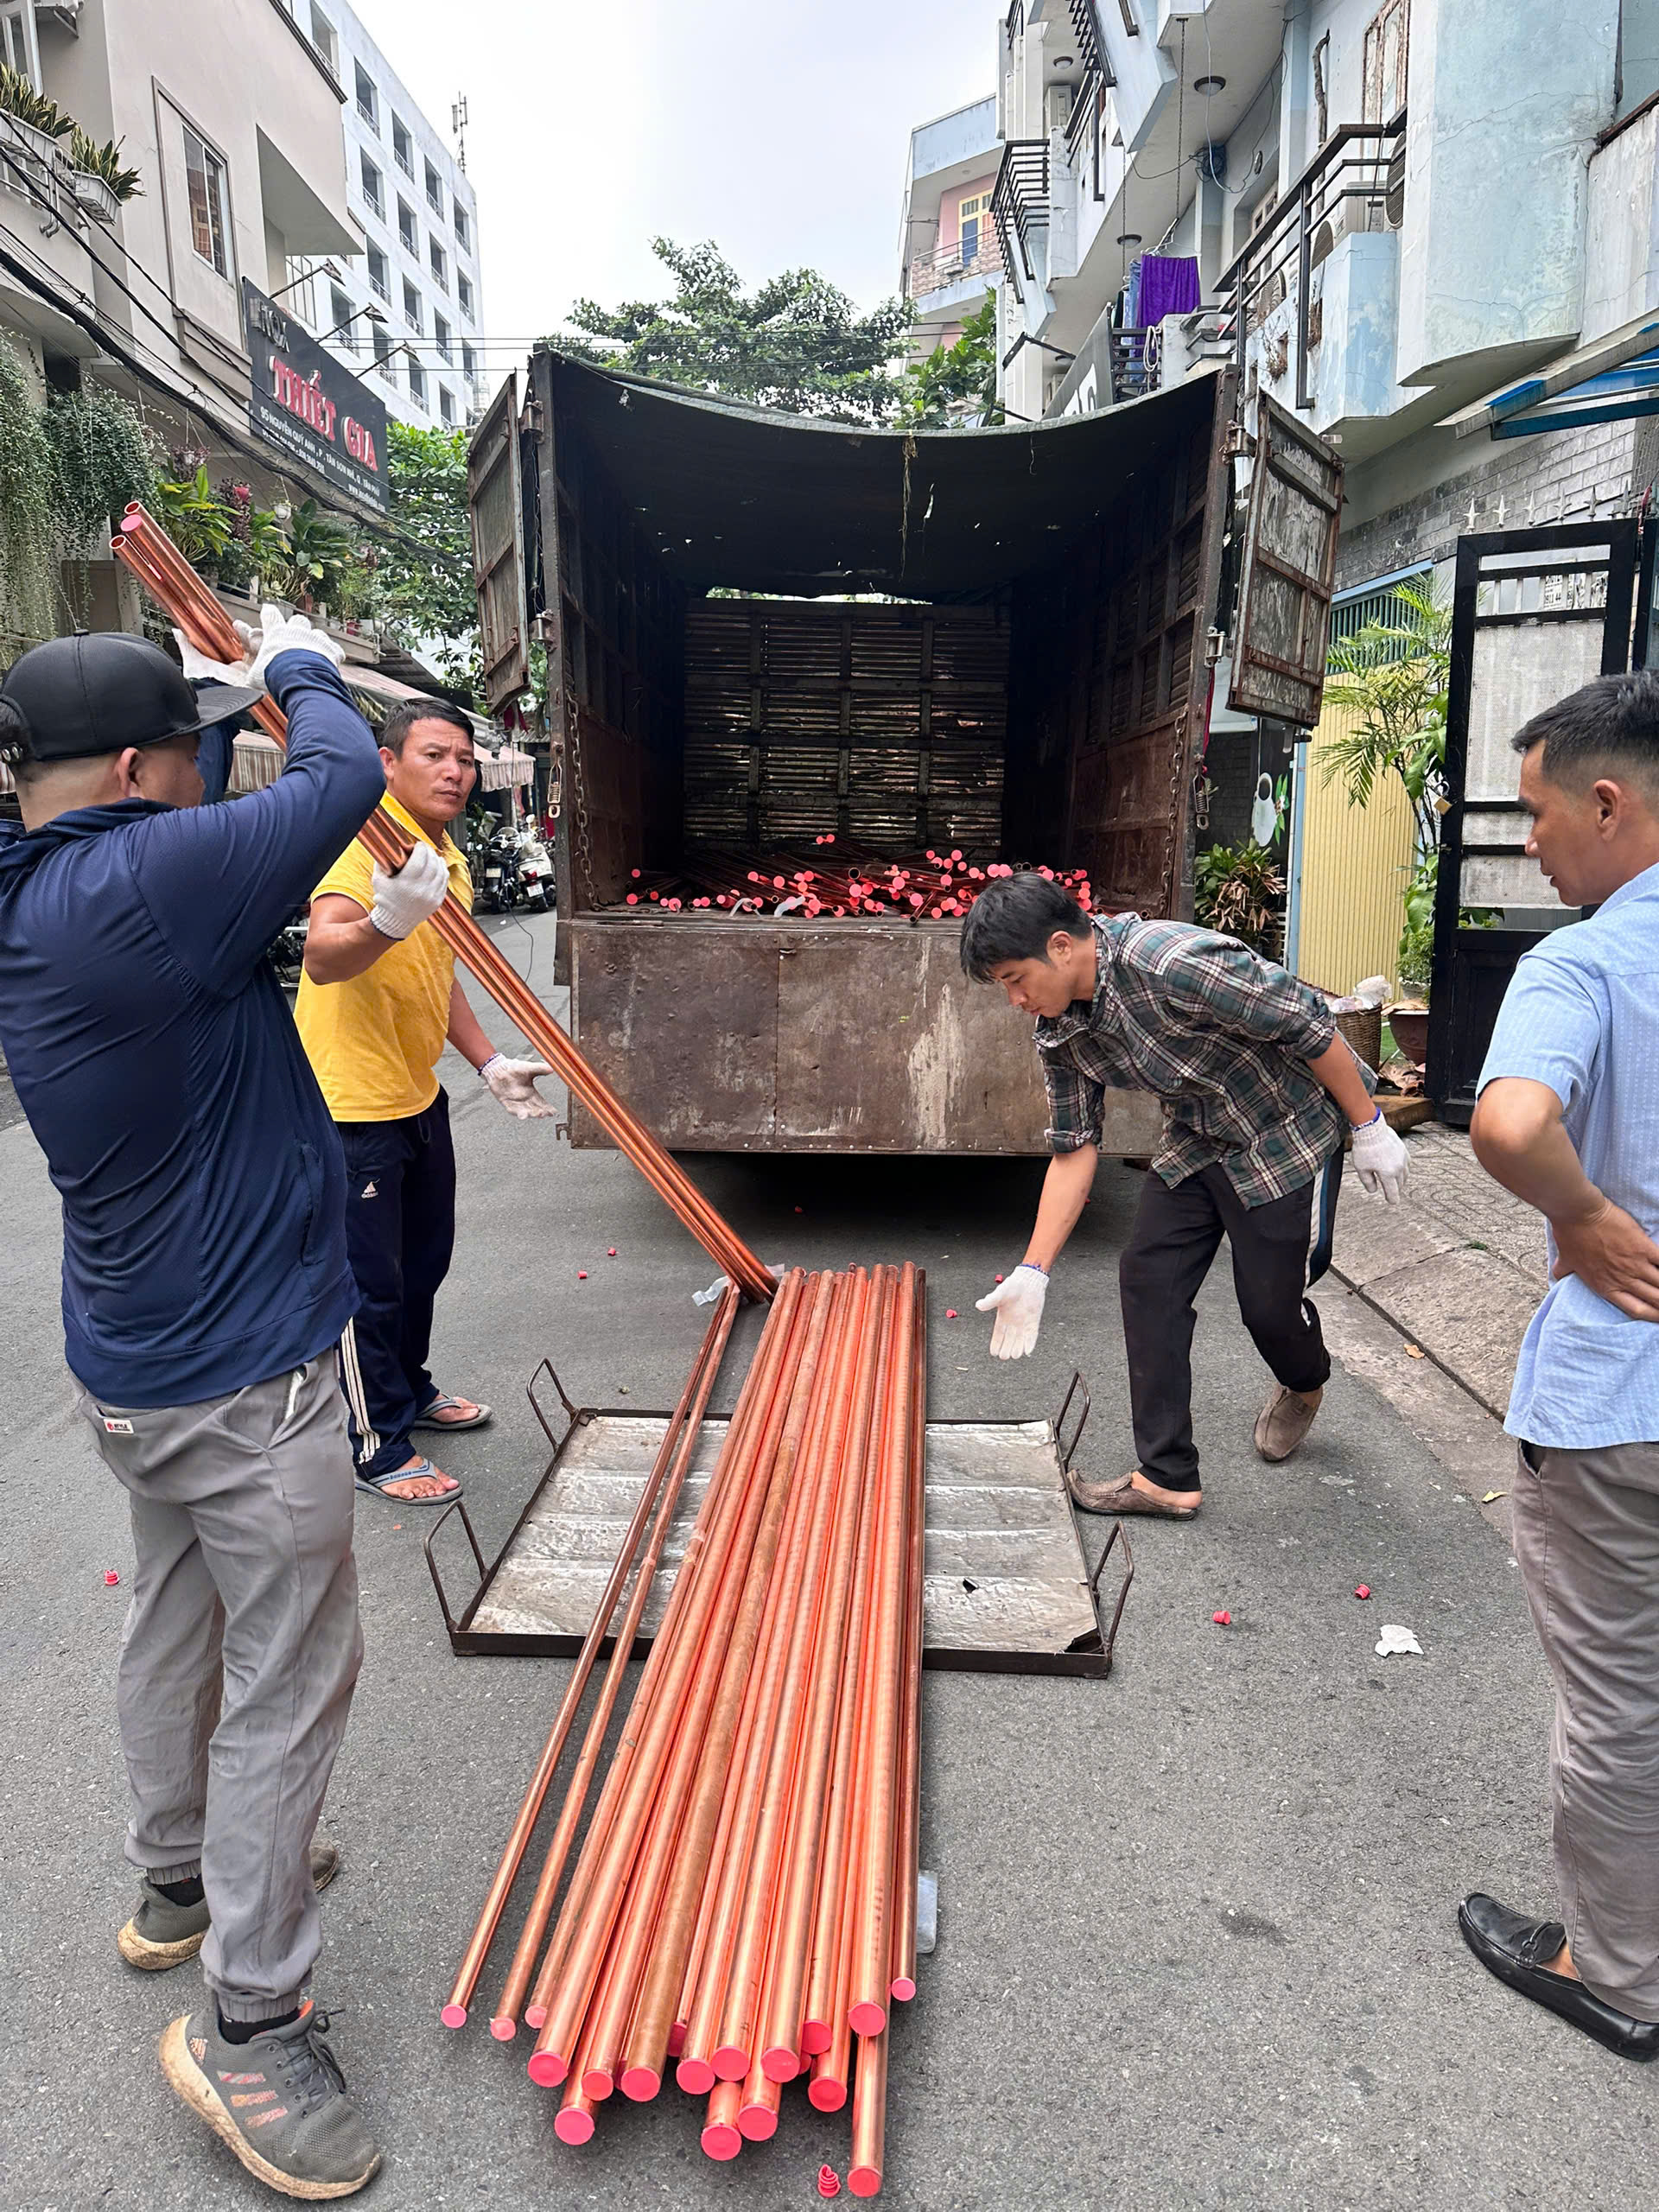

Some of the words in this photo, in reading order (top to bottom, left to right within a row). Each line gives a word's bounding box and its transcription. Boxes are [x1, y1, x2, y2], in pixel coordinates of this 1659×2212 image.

[260, 405, 270, 422] 95
[269, 355, 337, 442] THIẾT
[343, 416, 378, 472] GIA
